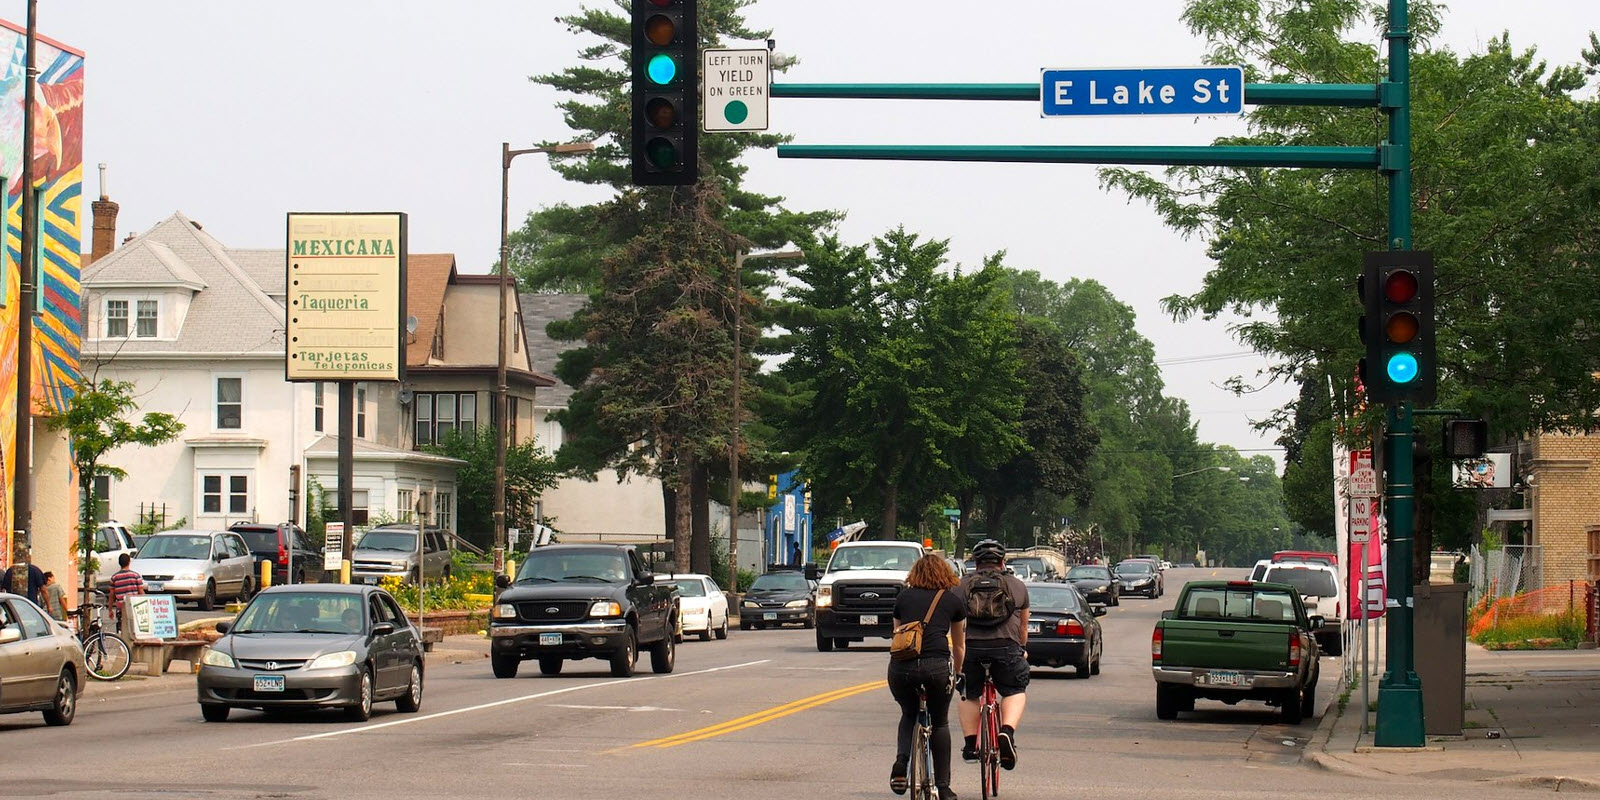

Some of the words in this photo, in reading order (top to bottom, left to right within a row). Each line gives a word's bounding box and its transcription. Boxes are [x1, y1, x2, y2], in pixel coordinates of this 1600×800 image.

[709, 56, 732, 66] LEFT
[739, 56, 763, 66] TURN
[719, 70, 754, 82] YIELD
[710, 86, 723, 97] ON
[729, 86, 763, 97] GREEN
[1055, 80, 1073, 105] E
[1089, 80, 1176, 105] Lake
[1192, 78, 1230, 105] St
[293, 239, 395, 256] MEXICANA
[299, 294, 369, 313] Taqueria
[299, 351, 369, 362] Tarjetas
[313, 361, 394, 373] Telefonicas
[1355, 503, 1366, 514] NO
[1351, 518, 1369, 526] PARKING
